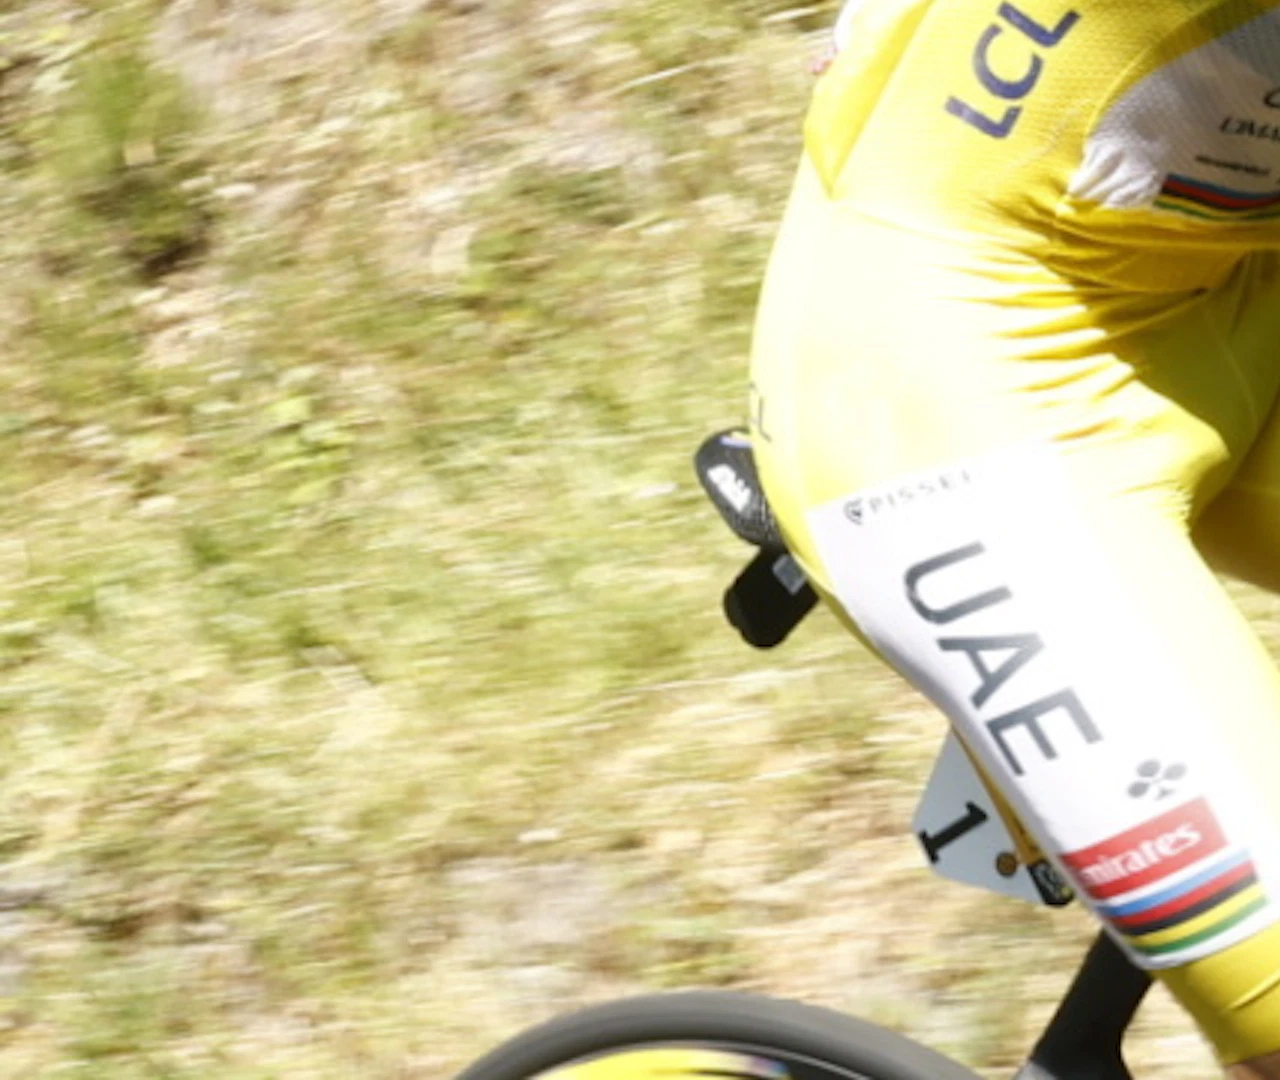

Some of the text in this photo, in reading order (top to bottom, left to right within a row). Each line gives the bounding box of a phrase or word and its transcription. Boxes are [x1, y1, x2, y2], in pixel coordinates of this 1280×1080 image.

[944, 0, 1082, 140] LCL
[904, 541, 1103, 777] UAE
[919, 797, 988, 863] 1
[1081, 823, 1201, 886] mirates
